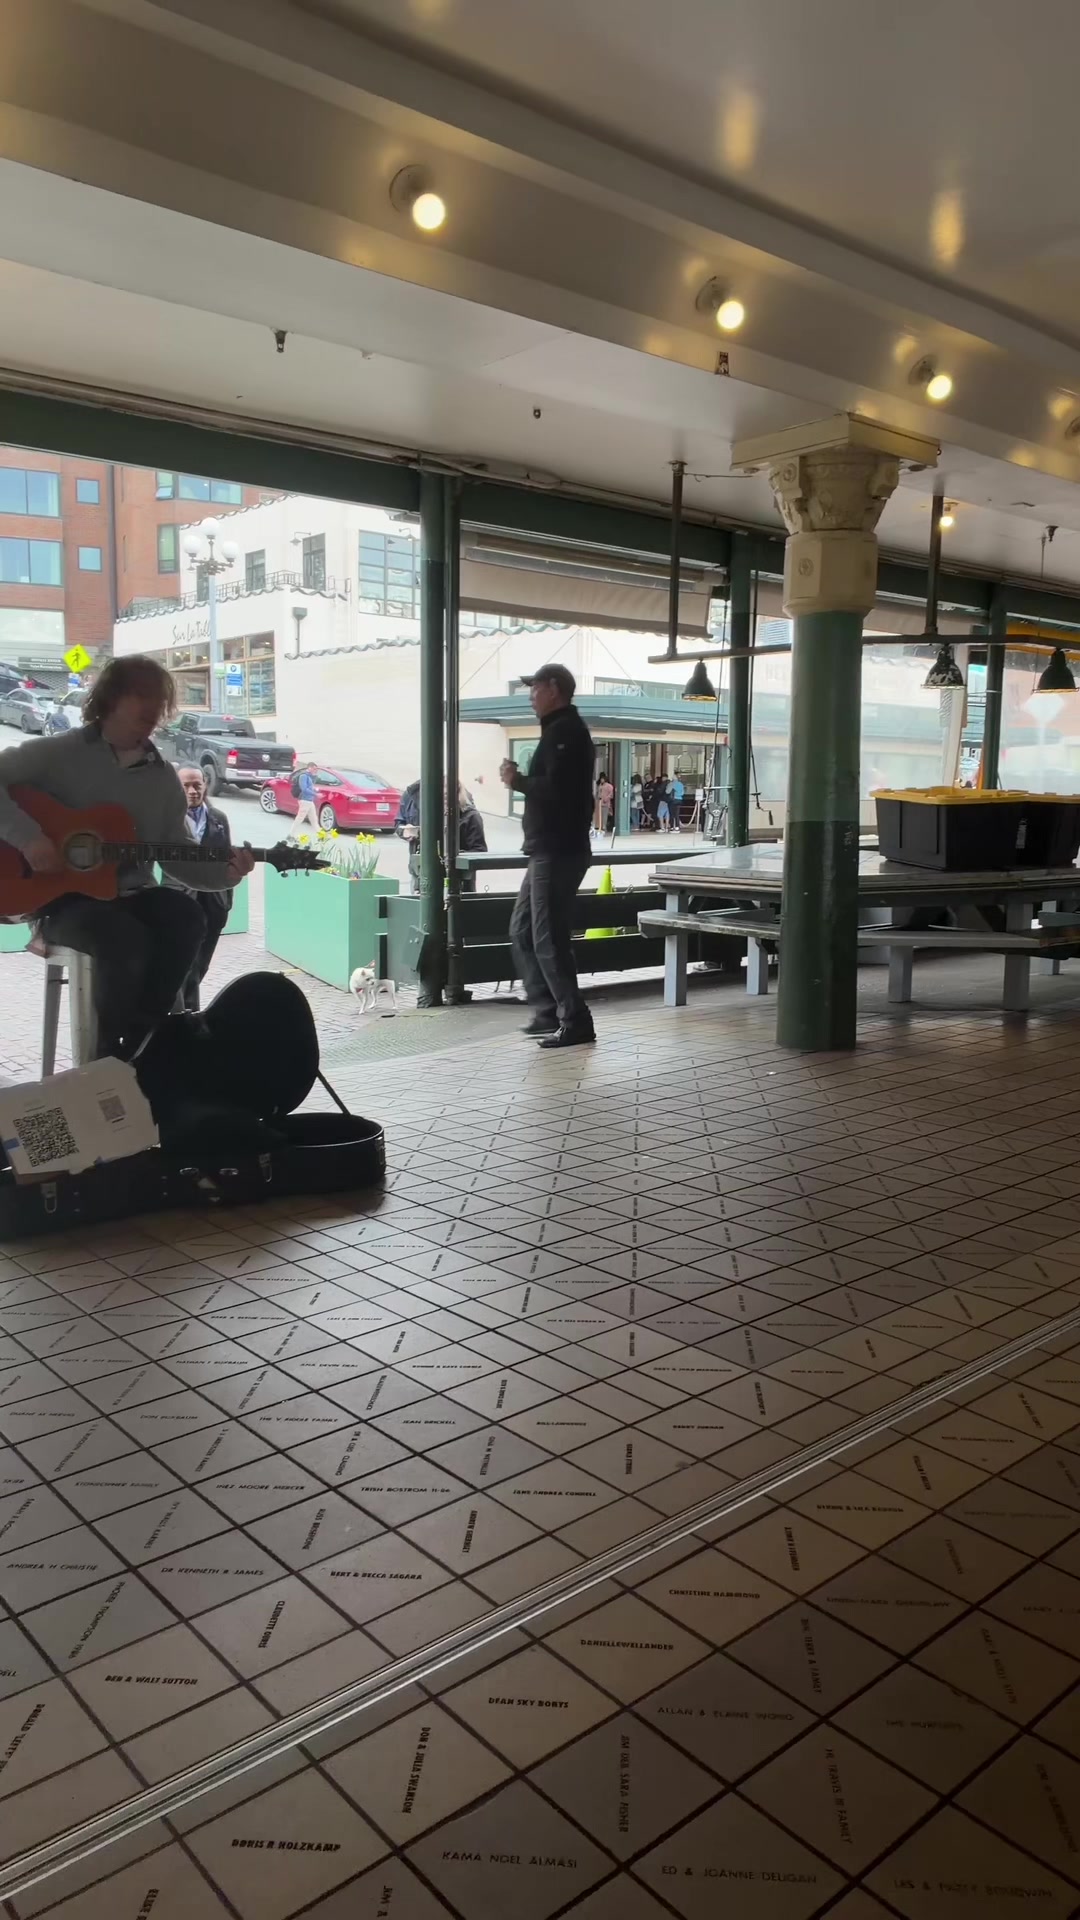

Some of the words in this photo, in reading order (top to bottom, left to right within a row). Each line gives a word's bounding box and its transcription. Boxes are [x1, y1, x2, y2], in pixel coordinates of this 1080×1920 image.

[176, 1567, 220, 1575] KENNETH
[104, 1581, 126, 1603] PHOEBE
[668, 1588, 710, 1597] CHRISTINE
[78, 1605, 110, 1641] THOMPSON
[264, 1600, 287, 1630] CLAUDETTE
[103, 1674, 124, 1682] BEN
[133, 1675, 162, 1684] WALT
[160, 1676, 199, 1686] SUTTON
[487, 1696, 514, 1706] DEAN
[516, 1697, 536, 1707] SKY
[537, 1698, 569, 1708] BORYS
[656, 1706, 694, 1716] ALLAN
[417, 1726, 432, 1742] DON
[409, 1751, 426, 1773] JULIA
[400, 1773, 421, 1814] SWANSON
[618, 1773, 630, 1798] SARA
[617, 1801, 630, 1833] FISHER
[834, 1809, 853, 1844] FAMILY
[229, 1837, 266, 1849] DORIS
[276, 1839, 342, 1854] HOLZKAMP
[440, 1850, 483, 1864] KAMA
[488, 1853, 522, 1866] NOEL
[527, 1855, 578, 1869] ALMASI
[661, 1864, 678, 1876] ED
[683, 1866, 694, 1877] &
[702, 1867, 755, 1881] JOANNE
